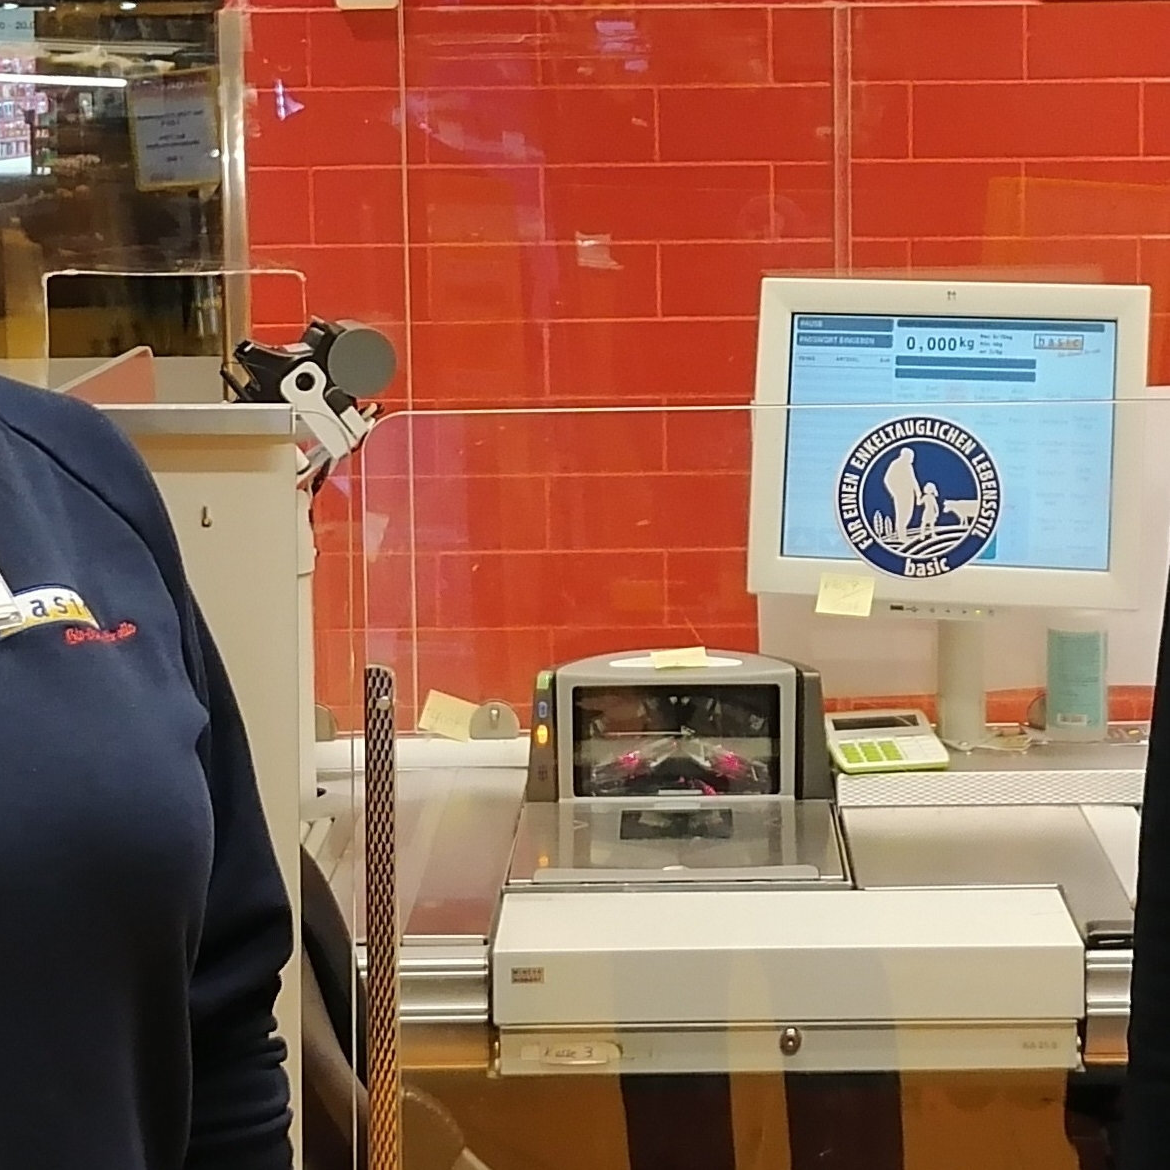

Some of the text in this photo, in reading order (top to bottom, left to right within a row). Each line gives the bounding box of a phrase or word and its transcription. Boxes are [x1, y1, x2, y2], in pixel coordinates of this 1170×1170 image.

[841, 420, 998, 550] FÜR EINEN ENKELTAUGLICHEN LEBENSSTIL
[904, 557, 950, 576] basic
[30, 593, 83, 617] asi
